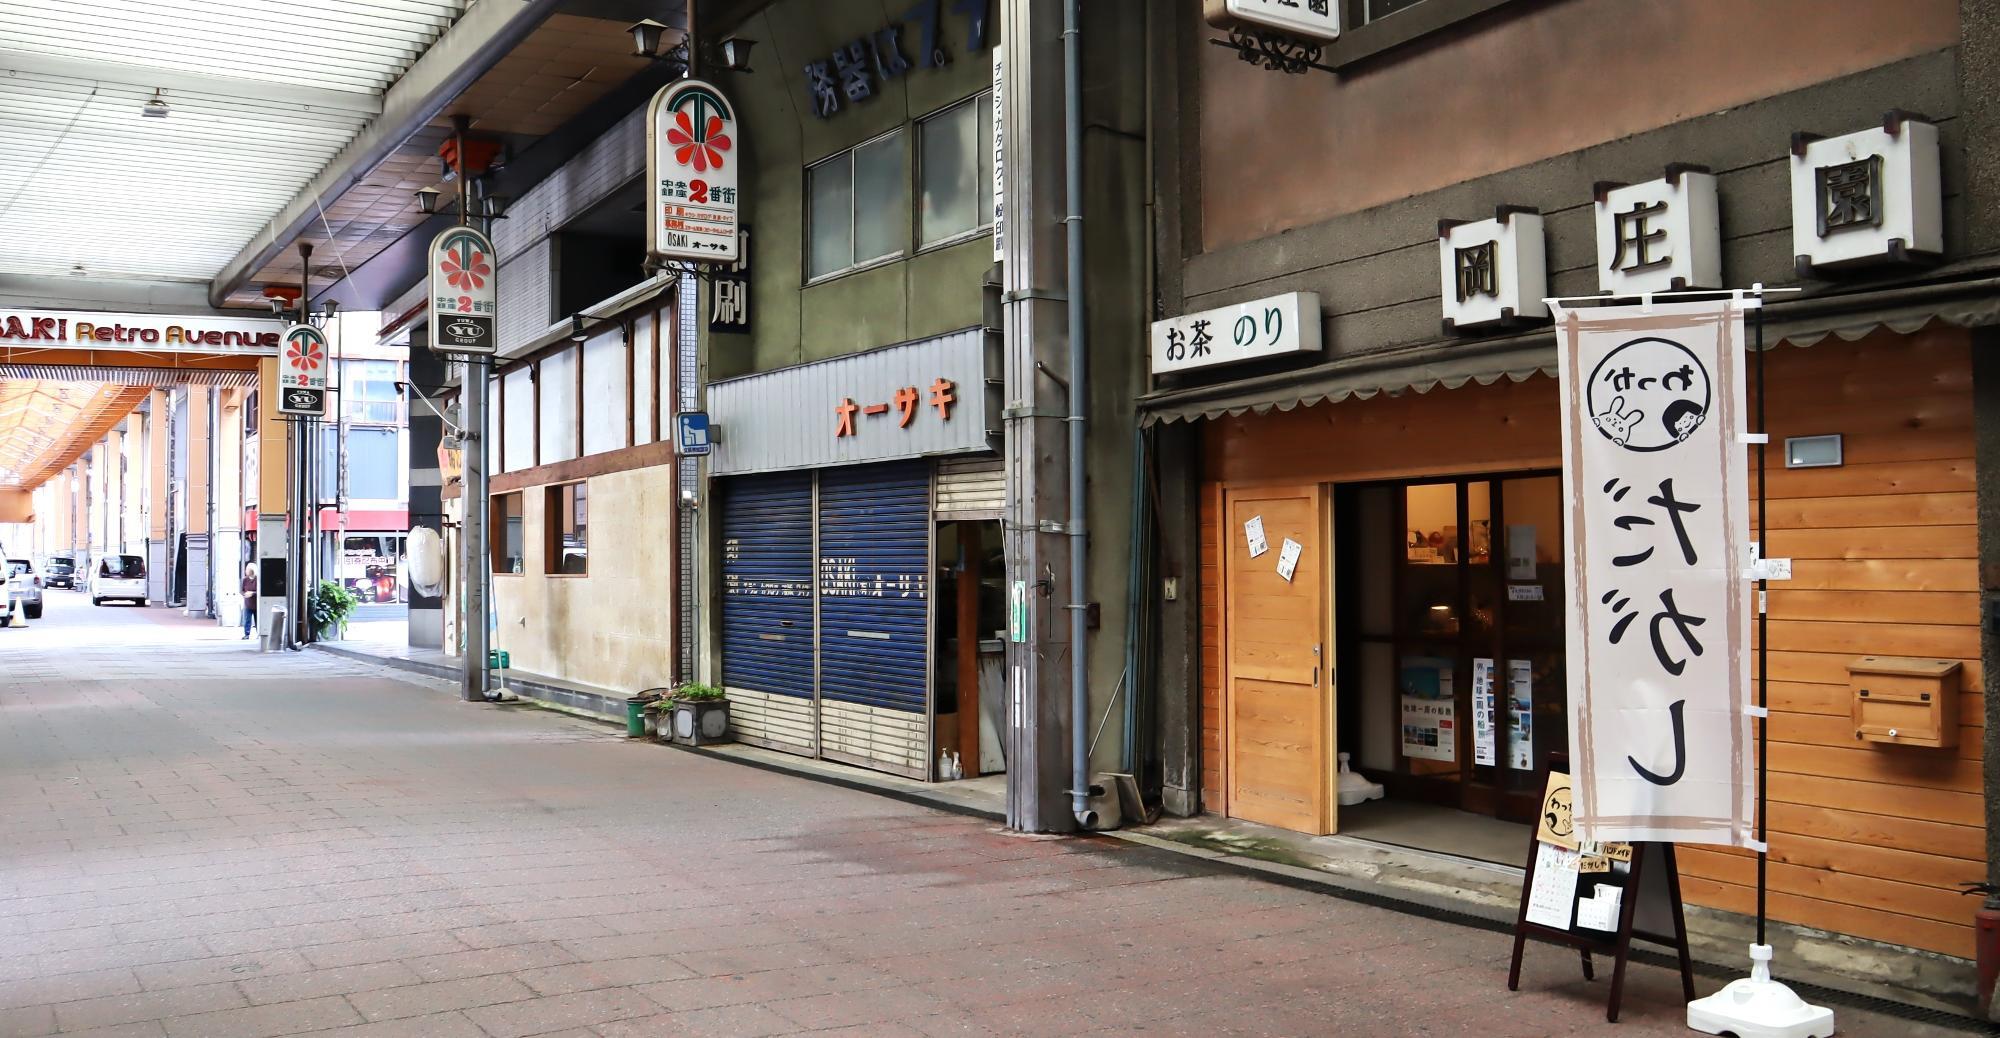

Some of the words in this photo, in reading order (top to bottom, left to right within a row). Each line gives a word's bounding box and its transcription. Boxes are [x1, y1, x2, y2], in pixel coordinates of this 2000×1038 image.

[692, 241, 728, 251] オーサキ
[0, 315, 67, 341] AKI
[75, 321, 160, 344] Retro
[165, 325, 281, 348] Avenue
[1166, 319, 1214, 361] お茶
[1233, 307, 1283, 346] のり
[834, 377, 957, 438] オーサキ
